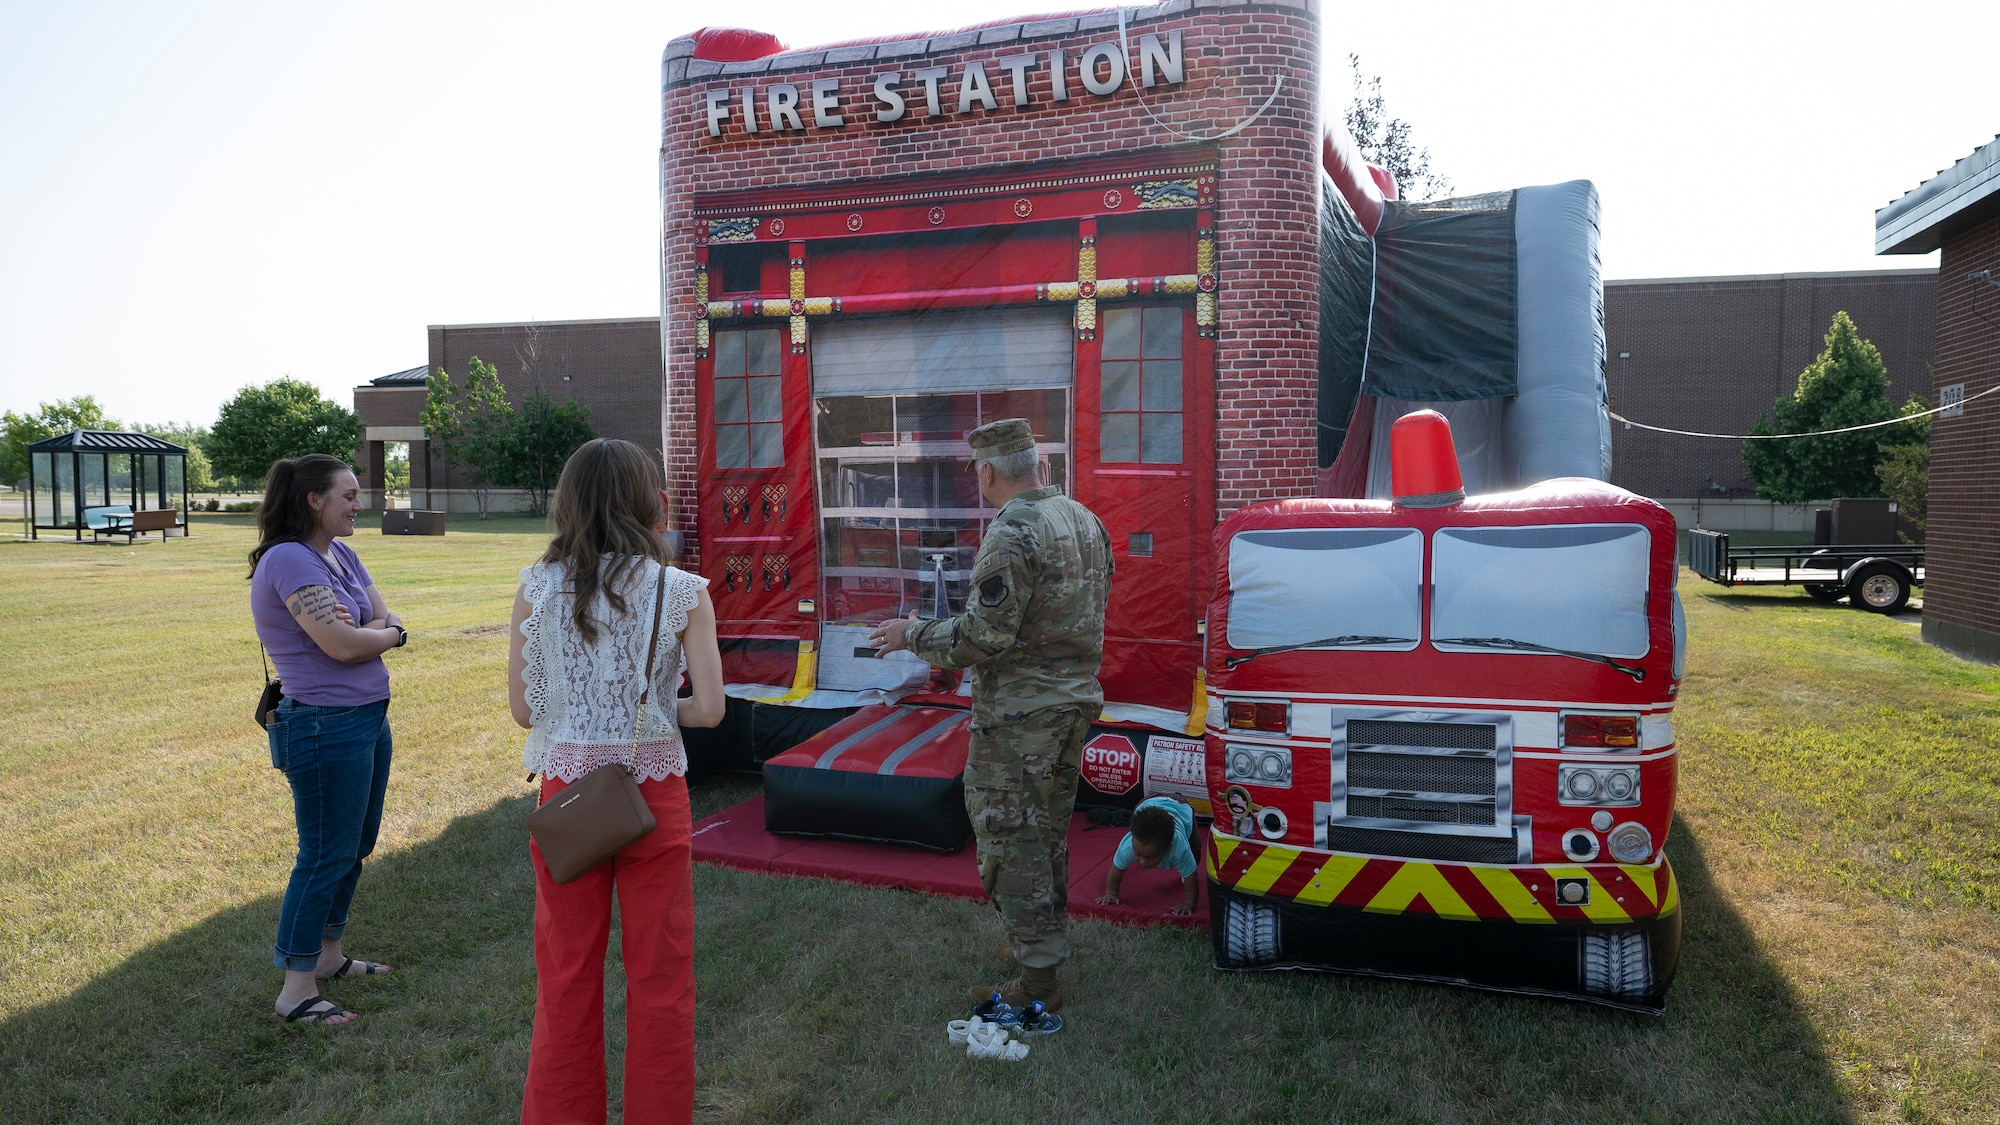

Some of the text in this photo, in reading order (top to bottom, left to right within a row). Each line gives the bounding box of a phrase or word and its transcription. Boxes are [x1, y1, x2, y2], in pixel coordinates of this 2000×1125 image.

[705, 30, 1185, 138] FIRE STATION
[1153, 740, 1174, 749] PATRON
[1175, 742, 1196, 751] SAFETY
[1085, 747, 1136, 769] STOP!
[1112, 768, 1131, 776] ENTER
[1090, 777, 1122, 786] OPERATOR
